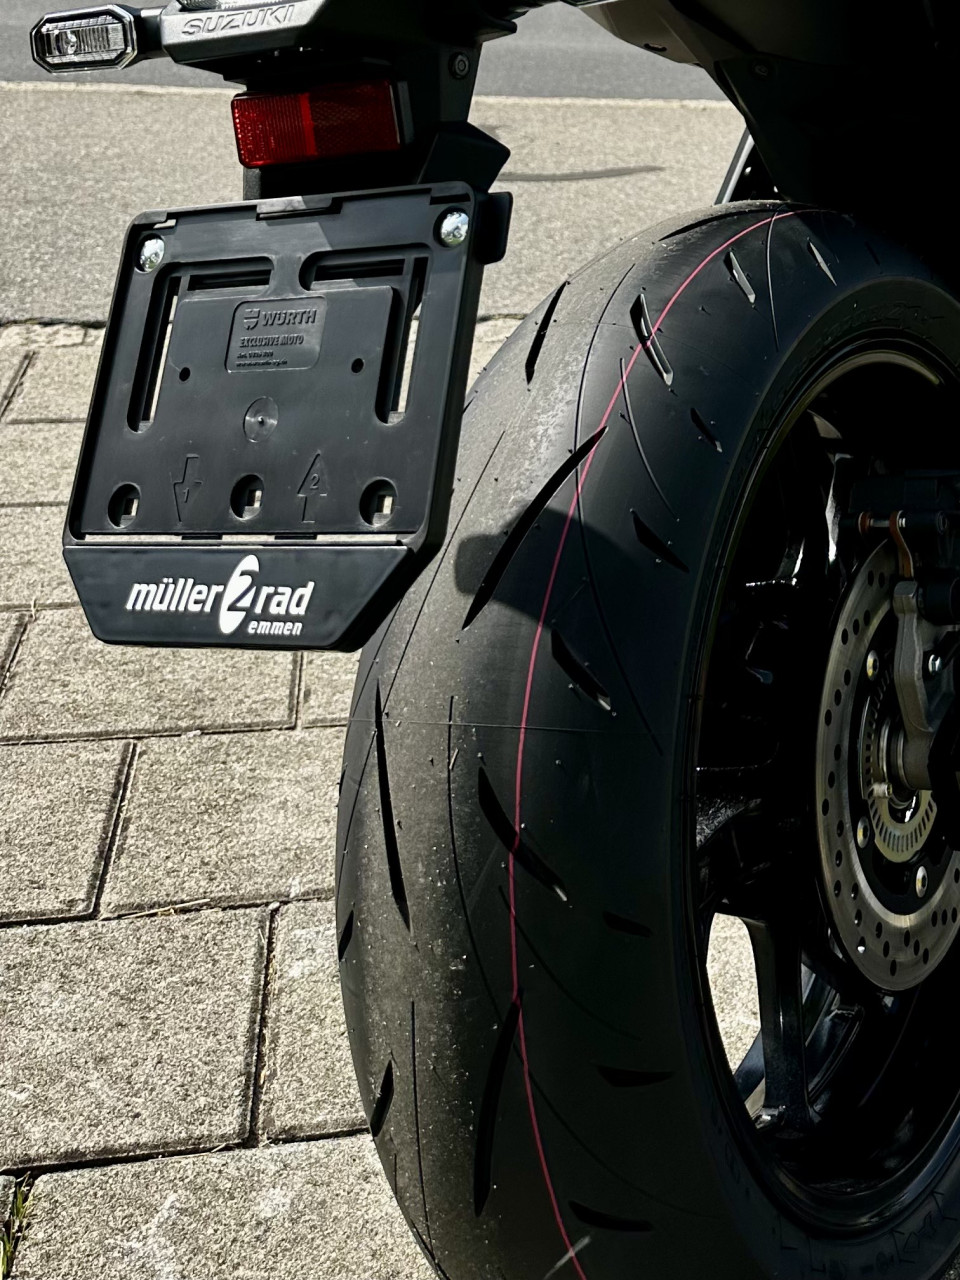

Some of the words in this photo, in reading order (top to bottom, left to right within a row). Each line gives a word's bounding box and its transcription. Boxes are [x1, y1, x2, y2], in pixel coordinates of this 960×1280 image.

[181, 4, 297, 36] SUZUKI
[261, 308, 318, 327] WÜRTH
[239, 333, 280, 348] EXCLUSIVE
[280, 332, 305, 346] MOTO
[309, 473, 321, 490] 2
[182, 487, 190, 504] 1
[247, 619, 303, 636] emmen
